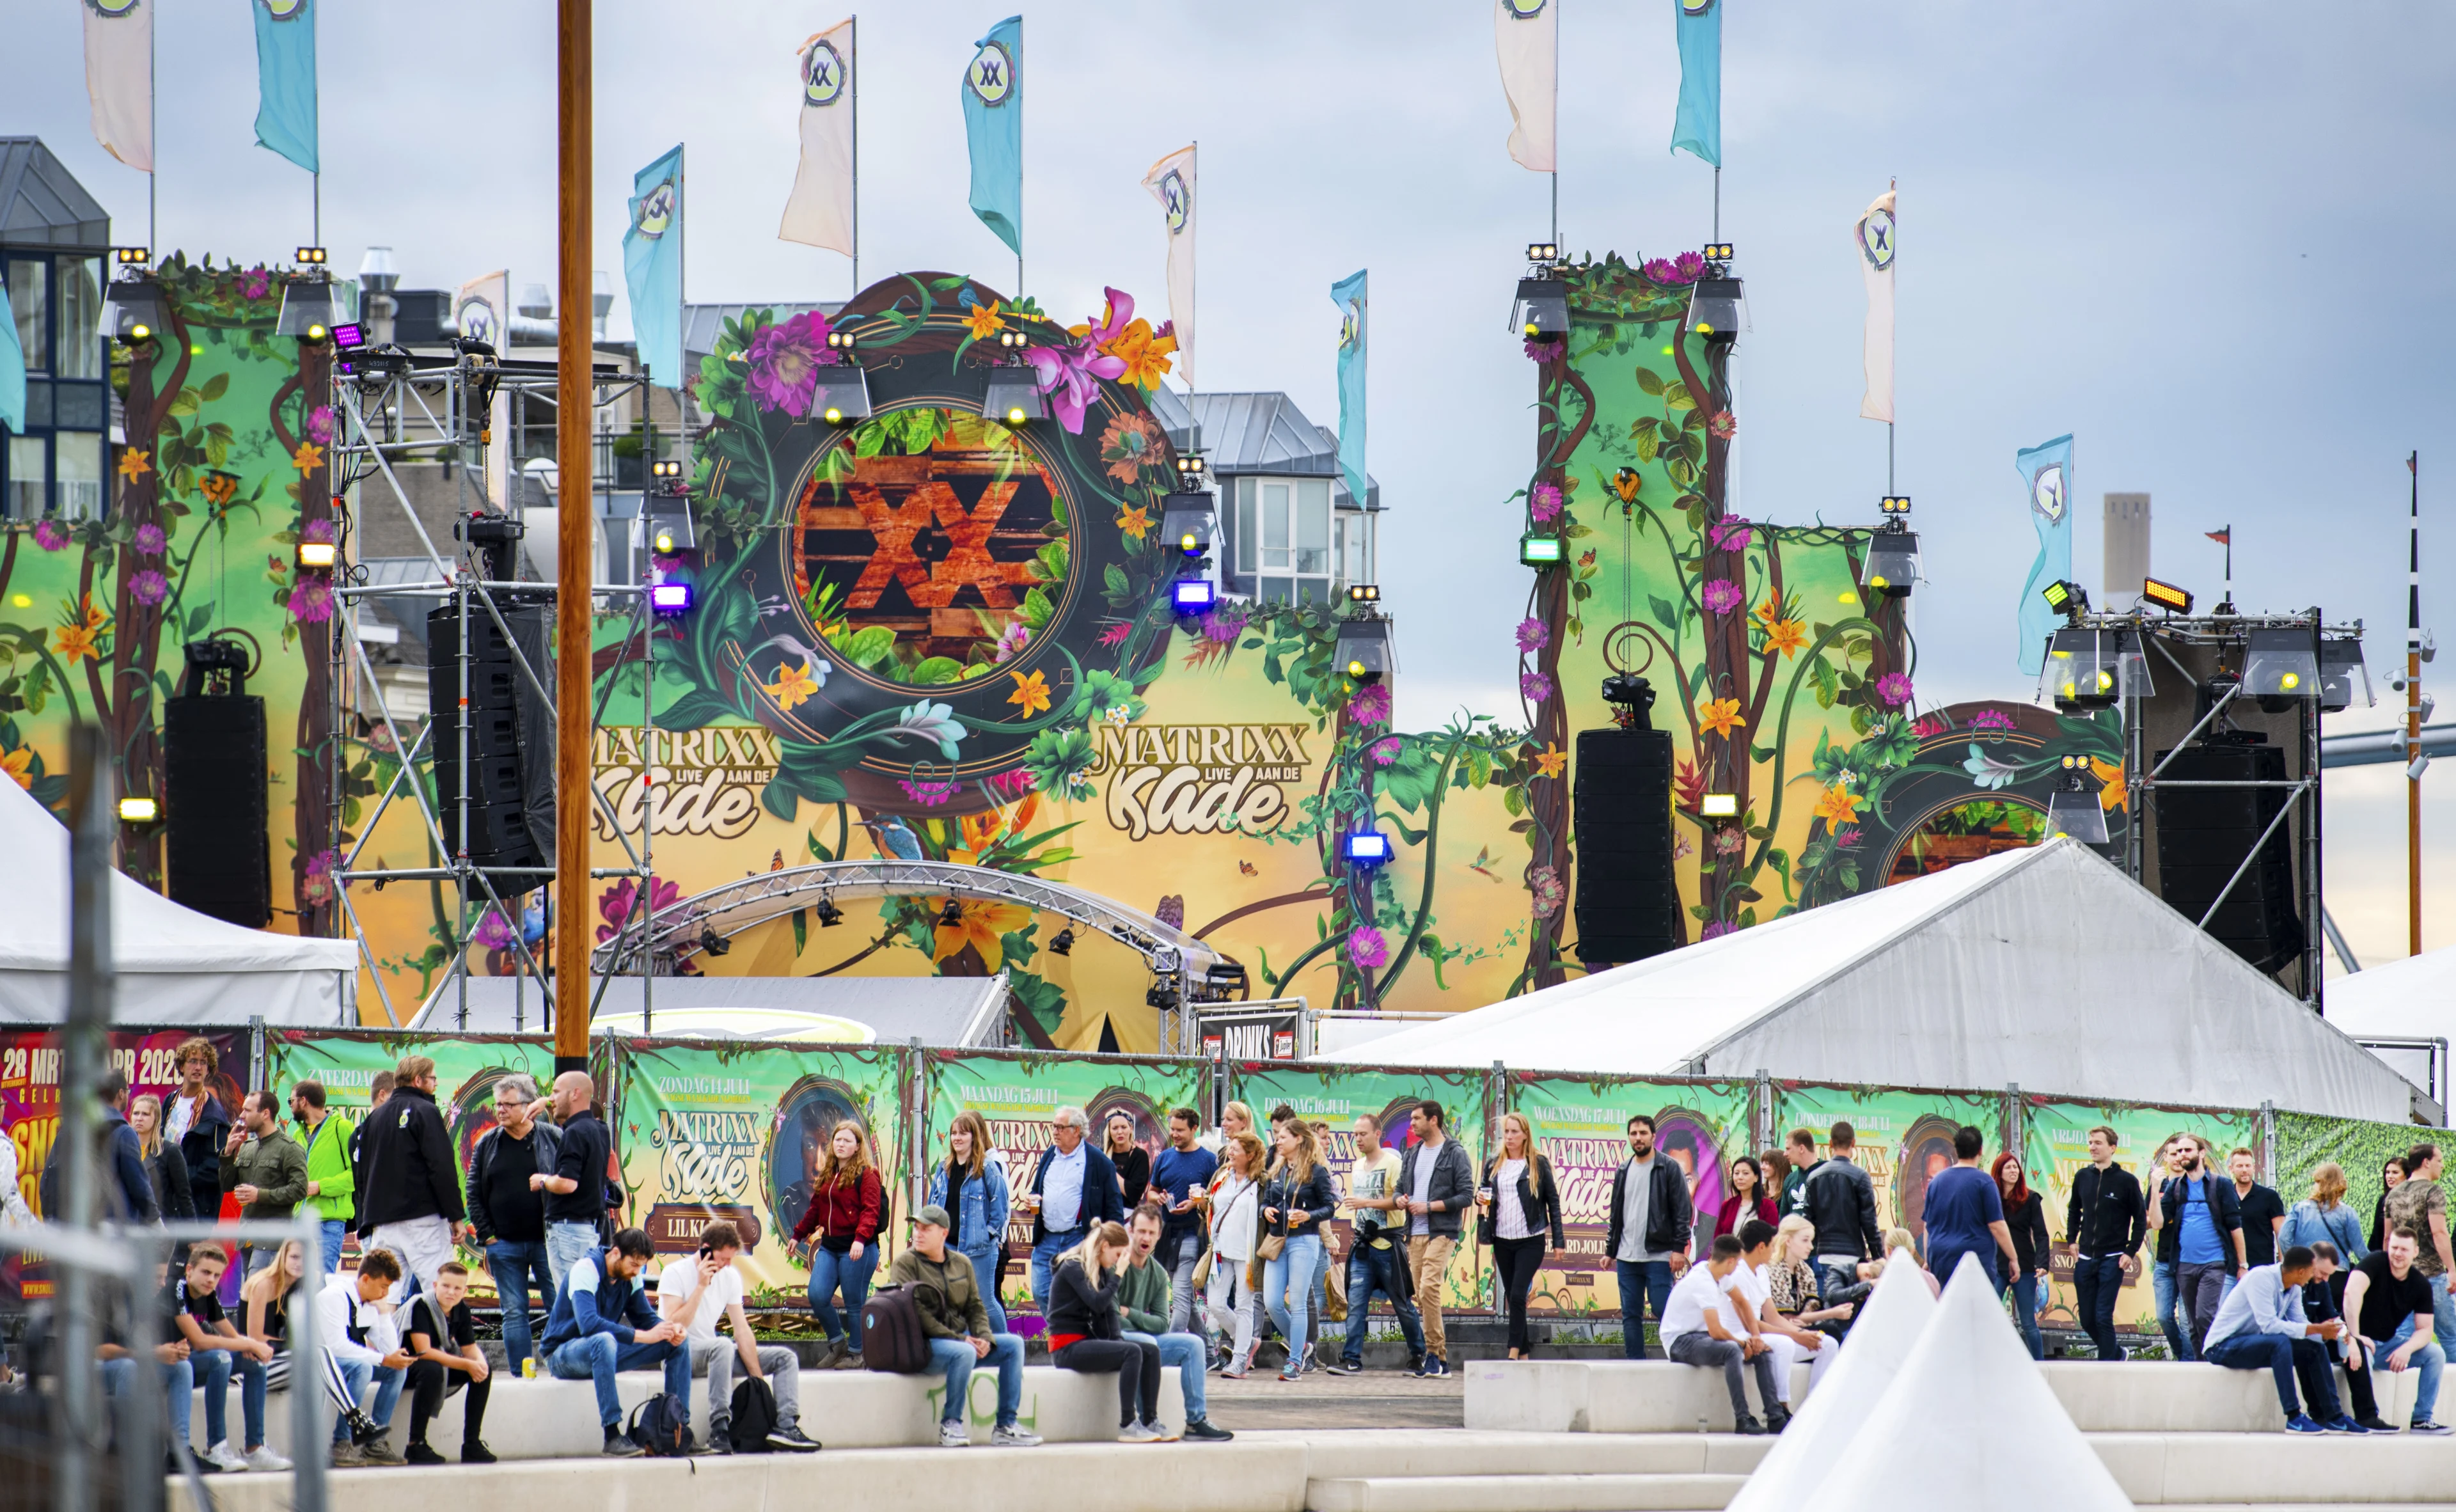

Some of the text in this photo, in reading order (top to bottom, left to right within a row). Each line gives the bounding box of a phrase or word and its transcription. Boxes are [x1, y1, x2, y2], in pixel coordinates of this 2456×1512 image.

[978, 59, 1004, 86] XX
[1094, 725, 1310, 772] MATRIXX
[676, 769, 770, 783] LIVE AAN DE
[1205, 768, 1299, 780] LIVE AAN DE
[1108, 766, 1288, 840] Kade
[1225, 1025, 1270, 1059] DRINKS
[3, 1048, 28, 1081] 28
[659, 1076, 750, 1094] ZONDAG 14 JULI
[960, 1085, 1058, 1105] MAANDAG 15 JULI
[1314, 1099, 1325, 1114] 16
[1326, 1099, 1350, 1114] JULI
[1534, 1106, 1626, 1124] WOENSDAG 17 JULI
[652, 1110, 759, 1146] MATRIXX
[1858, 1116, 1867, 1130] 18
[1868, 1117, 1890, 1131] JULI
[2052, 1129, 2090, 1145] VRIJDA
[708, 1146, 754, 1156] LIVE AAN DE
[1012, 1153, 1025, 1163] LIVE
[1540, 1138, 1626, 1169] MATRIXX
[662, 1142, 748, 1199] Kade
[1344, 1162, 1351, 1172] DE
[1583, 1170, 1594, 1179] LIVE
[668, 1218, 688, 1237] LIL
